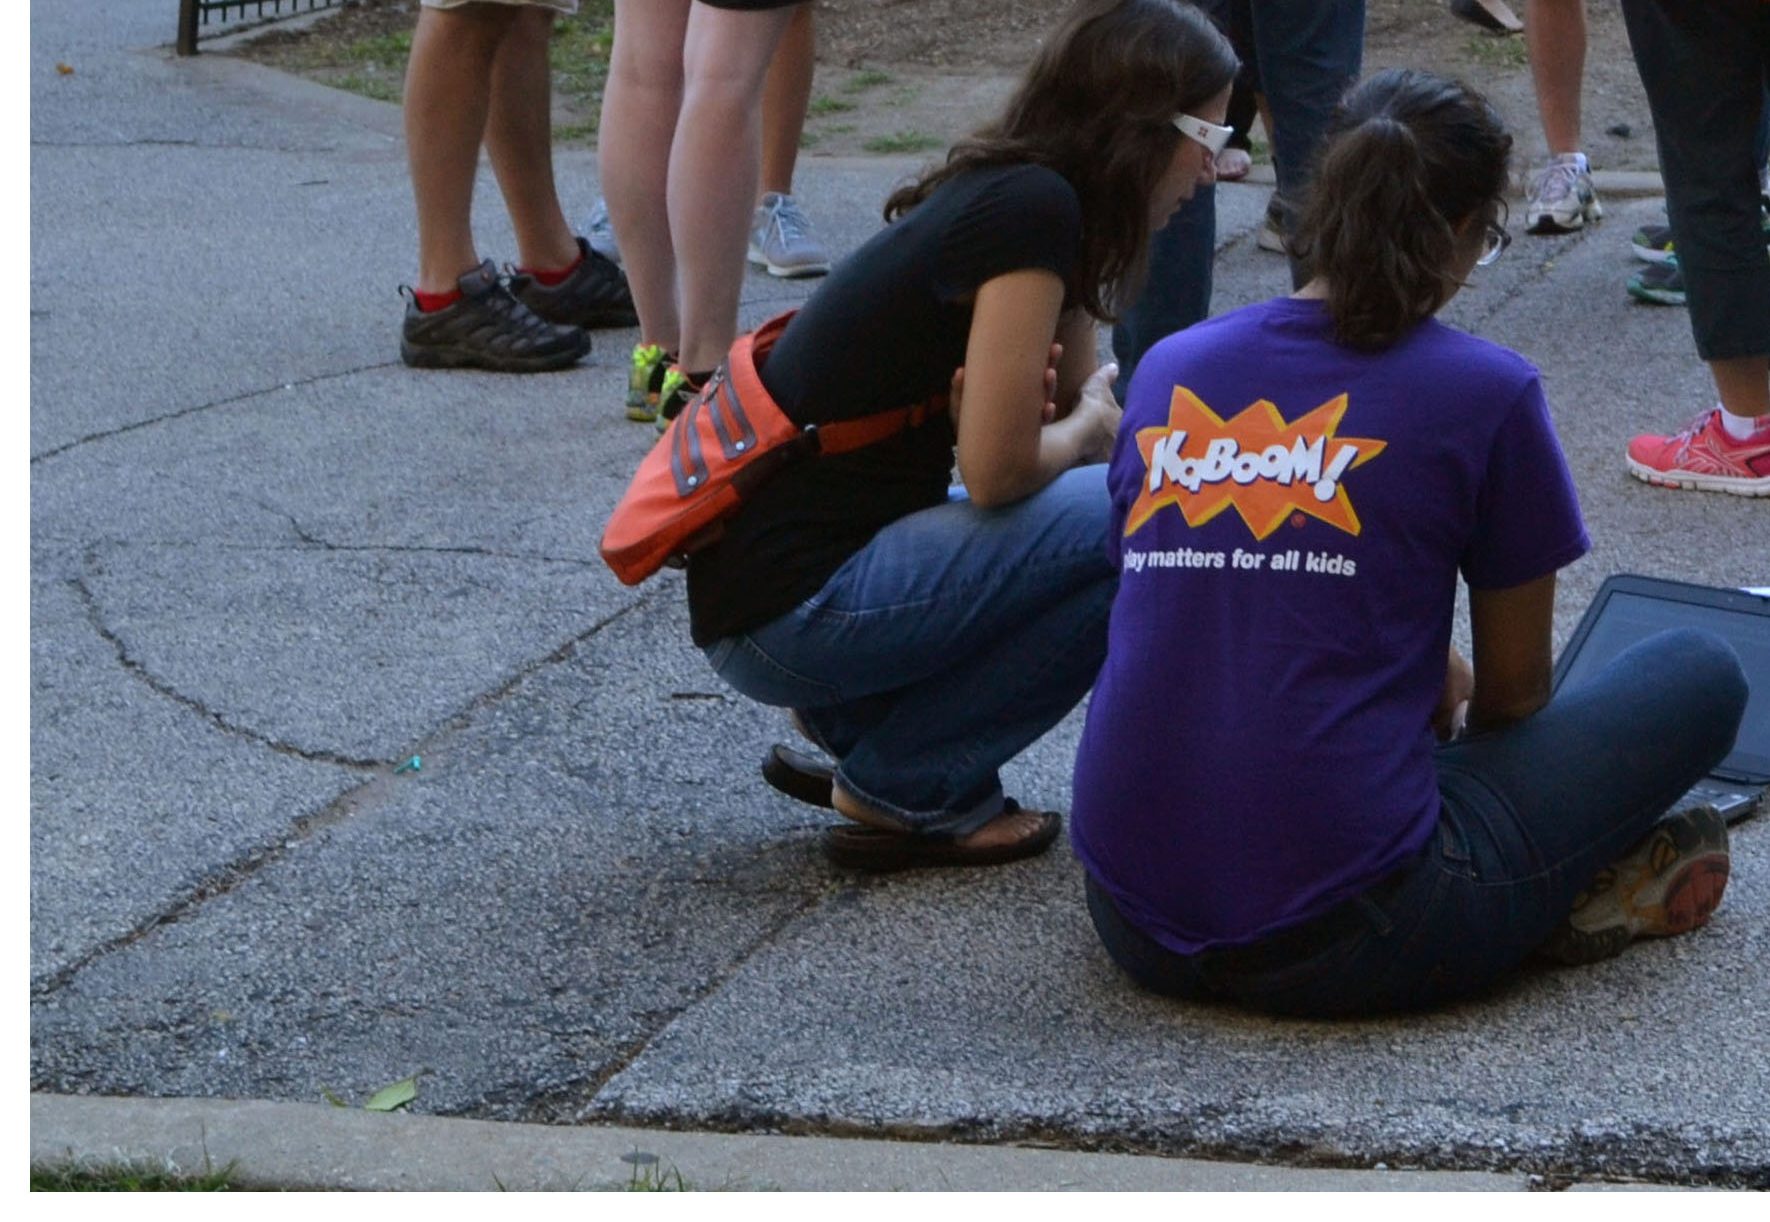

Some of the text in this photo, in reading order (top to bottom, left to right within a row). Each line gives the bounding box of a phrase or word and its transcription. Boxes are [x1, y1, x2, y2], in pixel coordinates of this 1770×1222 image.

[1148, 548, 1226, 569] matters
[1231, 548, 1266, 571] for
[1270, 550, 1301, 572] all
[1305, 552, 1357, 577] kids
